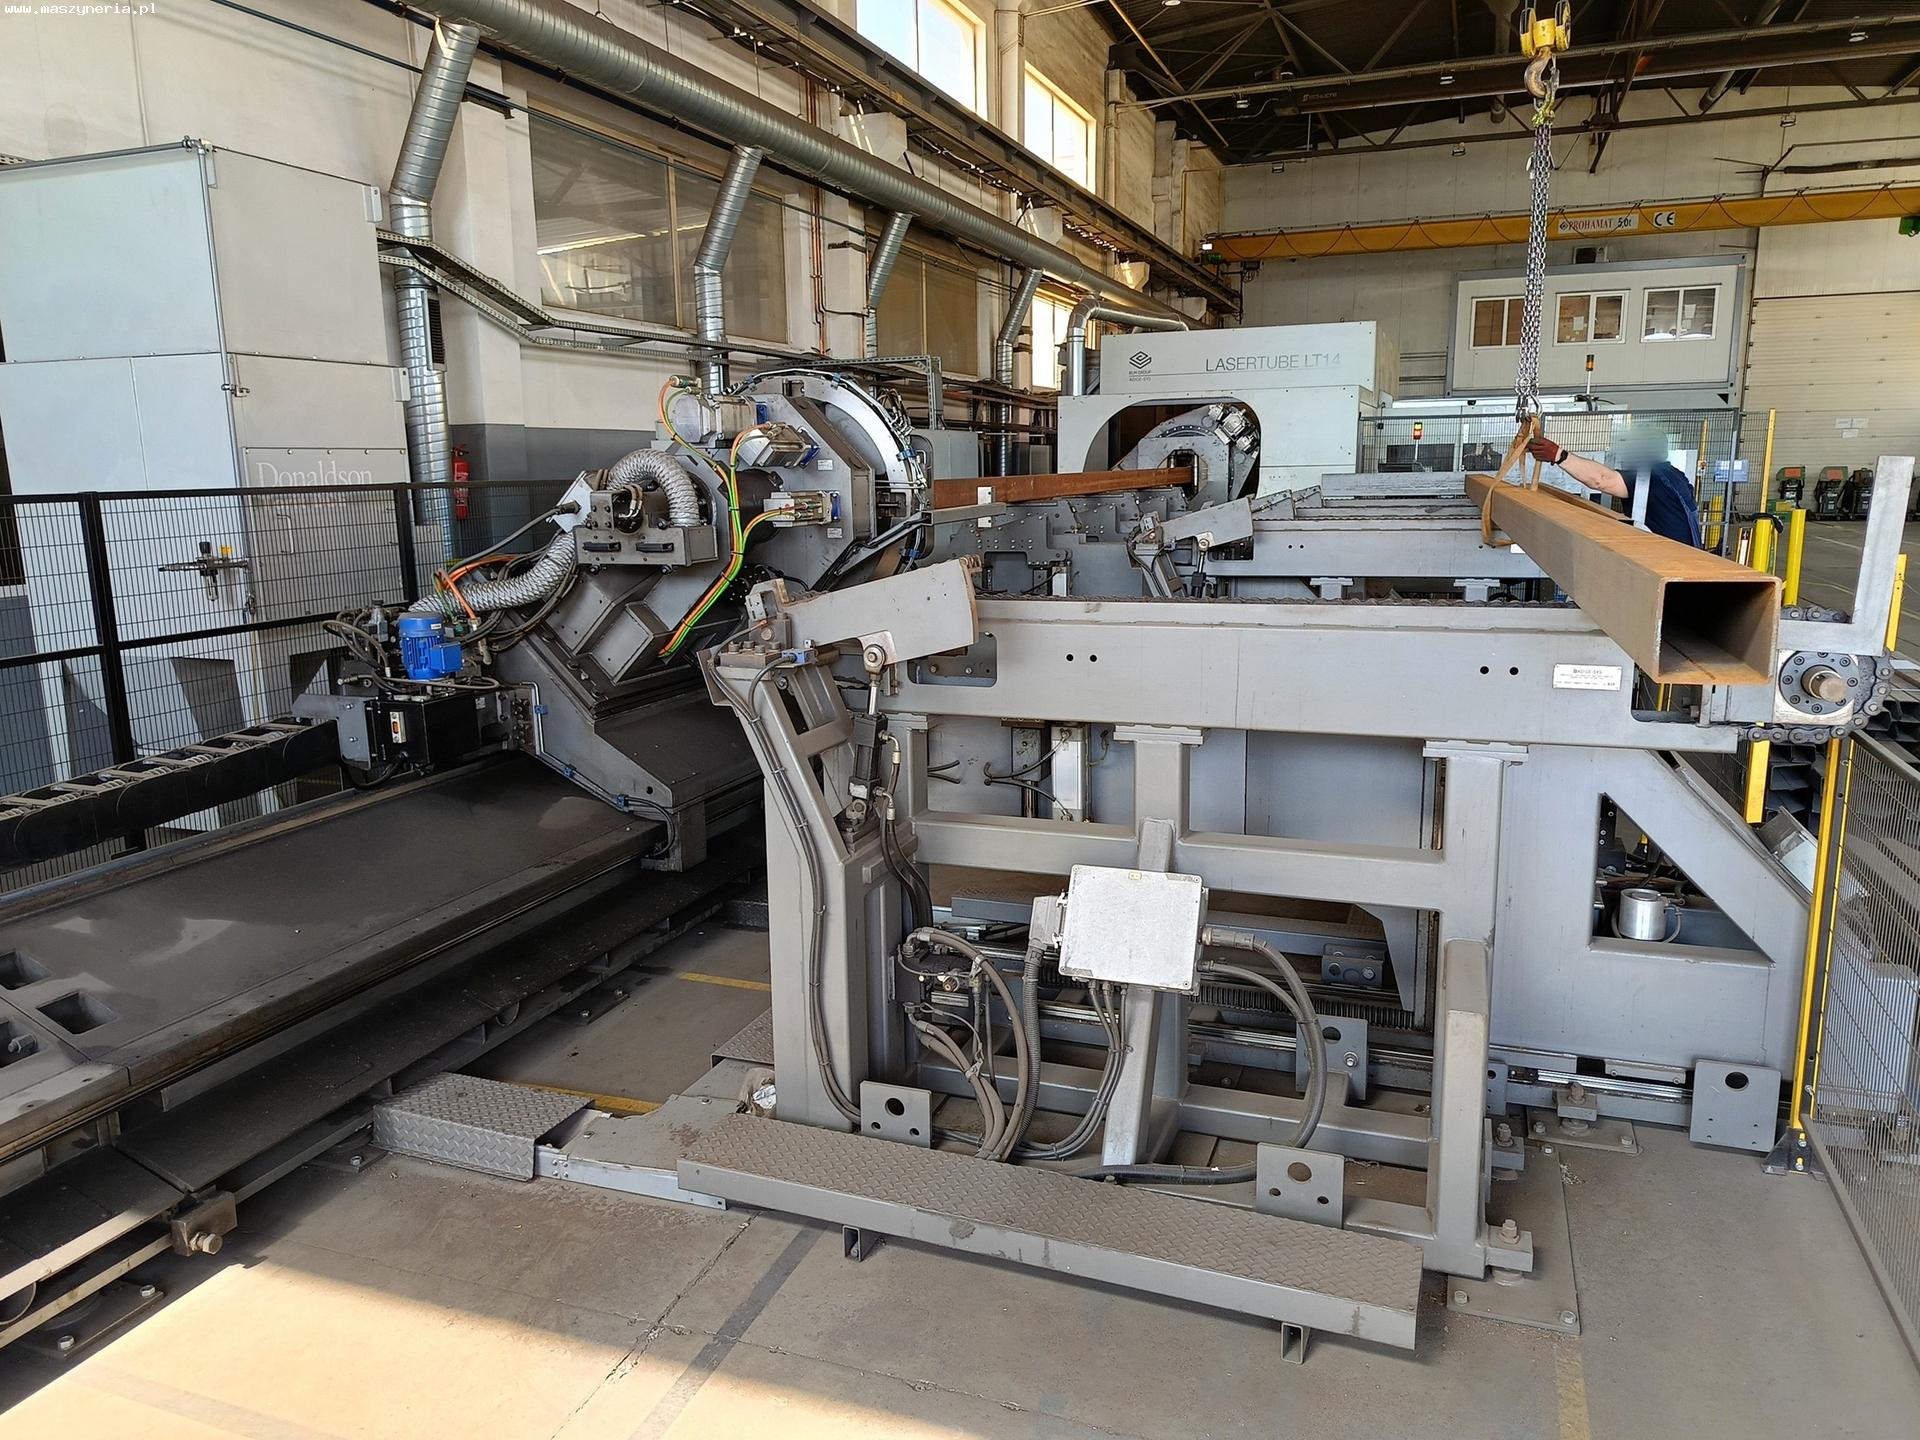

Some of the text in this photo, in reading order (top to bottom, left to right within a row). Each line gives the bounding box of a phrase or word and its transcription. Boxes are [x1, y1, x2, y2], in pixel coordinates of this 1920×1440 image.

[1654, 211, 1675, 227] CE
[1205, 352, 1341, 372] LASERTUBE LT14
[255, 460, 372, 488] Donaldson
